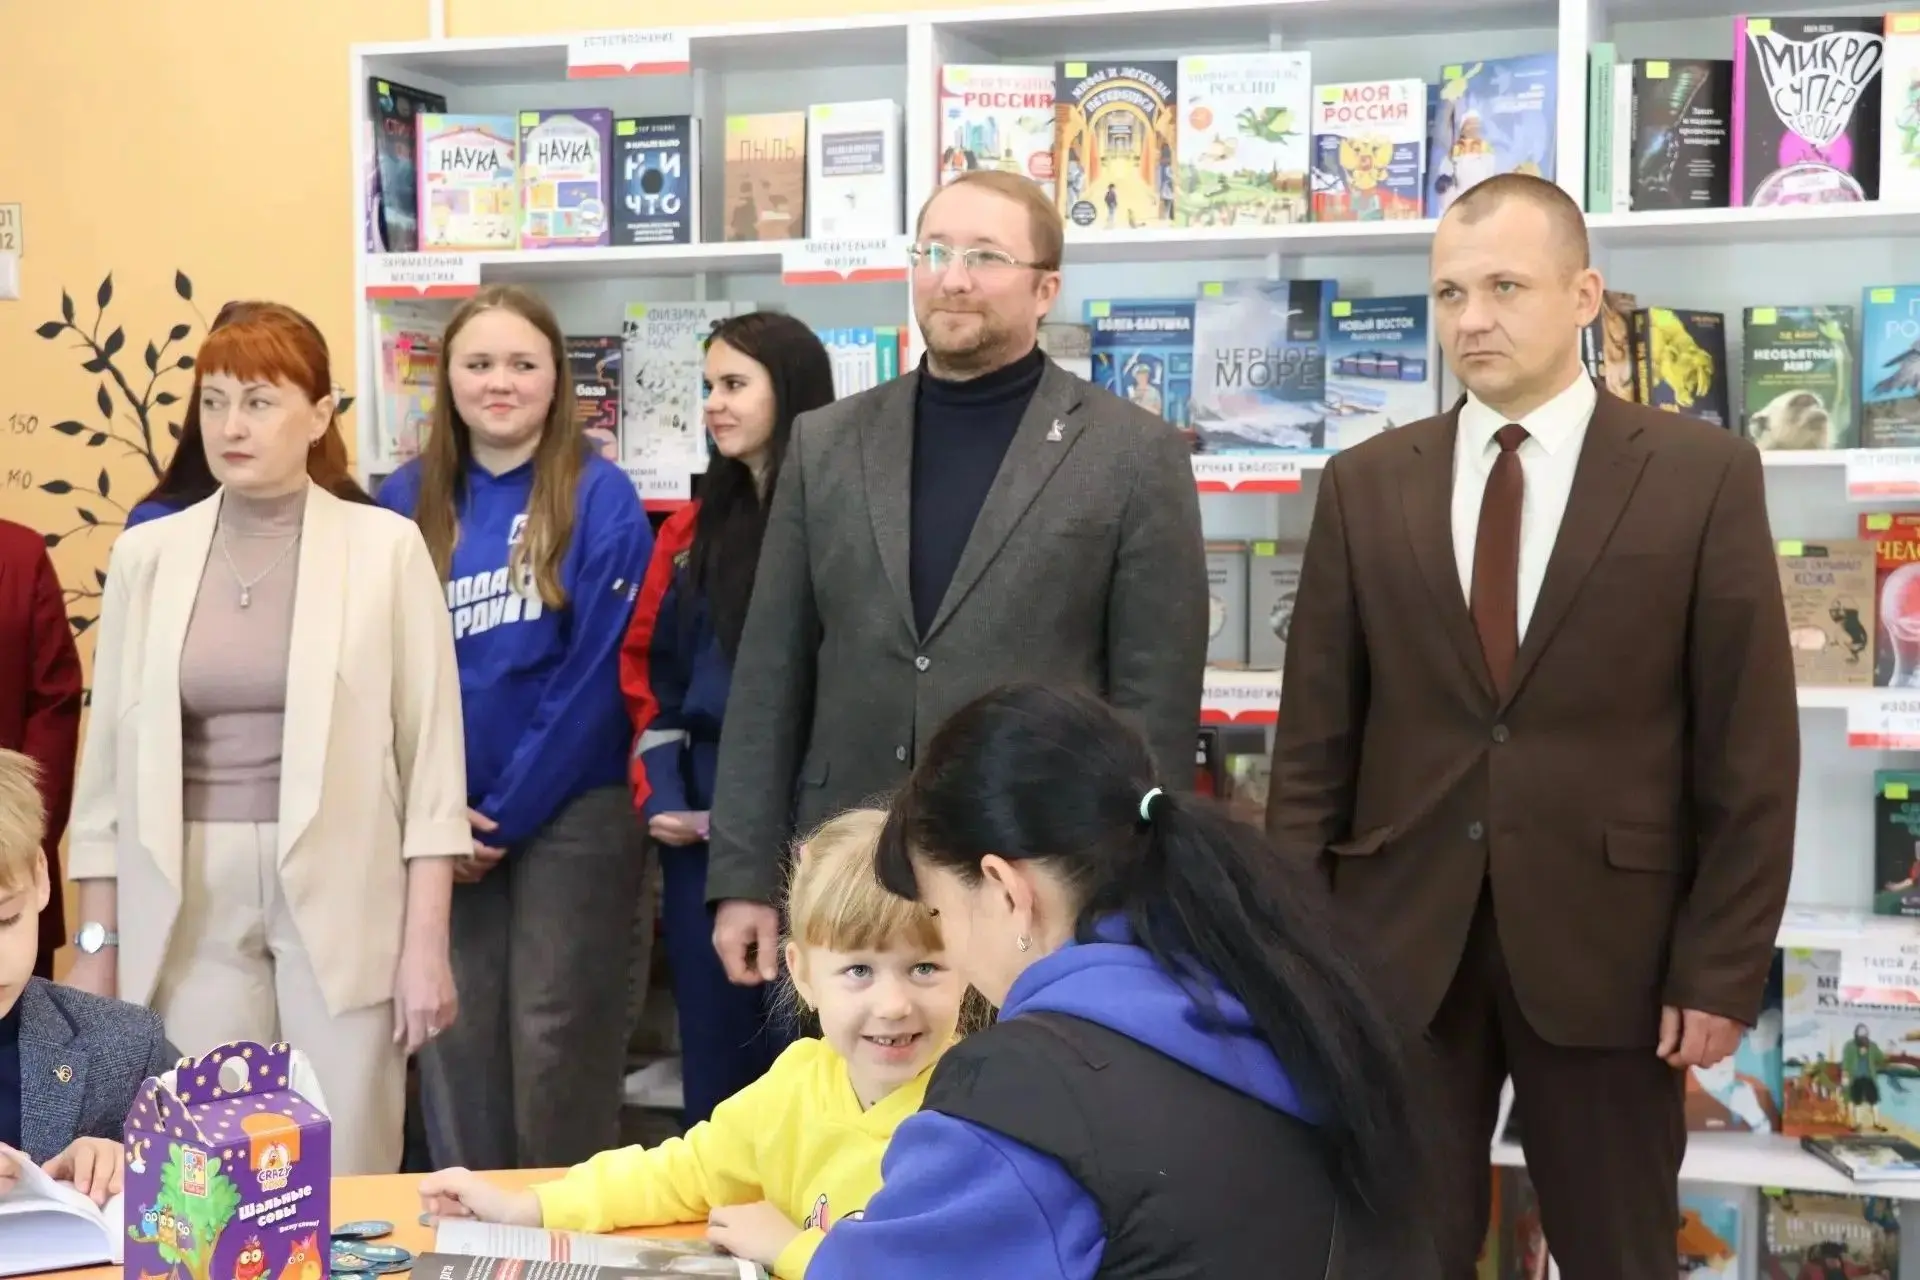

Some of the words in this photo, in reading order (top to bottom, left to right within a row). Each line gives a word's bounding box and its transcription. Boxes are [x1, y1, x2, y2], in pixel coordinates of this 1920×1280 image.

[1757, 36, 1883, 87] МИКРО
[964, 92, 1053, 107] РОССИЯ
[1343, 85, 1390, 101] МОЯ
[1776, 74, 1856, 117] СУПЕР
[1324, 103, 1408, 122] РОССИЯ
[440, 146, 500, 171] НАУКА
[538, 137, 593, 165] НАУКА
[740, 137, 796, 163] ПЫЛЬ
[625, 193, 680, 216] ЧТО
[648, 308, 707, 322] ФИЗИКА
[648, 322, 701, 336] ВОКРУГ
[1338, 319, 1374, 331] НОВЫЙ
[648, 338, 677, 350] НАС
[1216, 347, 1318, 363] ЧЕРНОЕ
[1216, 361, 1317, 387] МОРЕ
[576, 384, 606, 396] база
[257, 1166, 293, 1182] CRAZY
[239, 1185, 313, 1220] Шальные
[257, 1203, 297, 1227] совы
